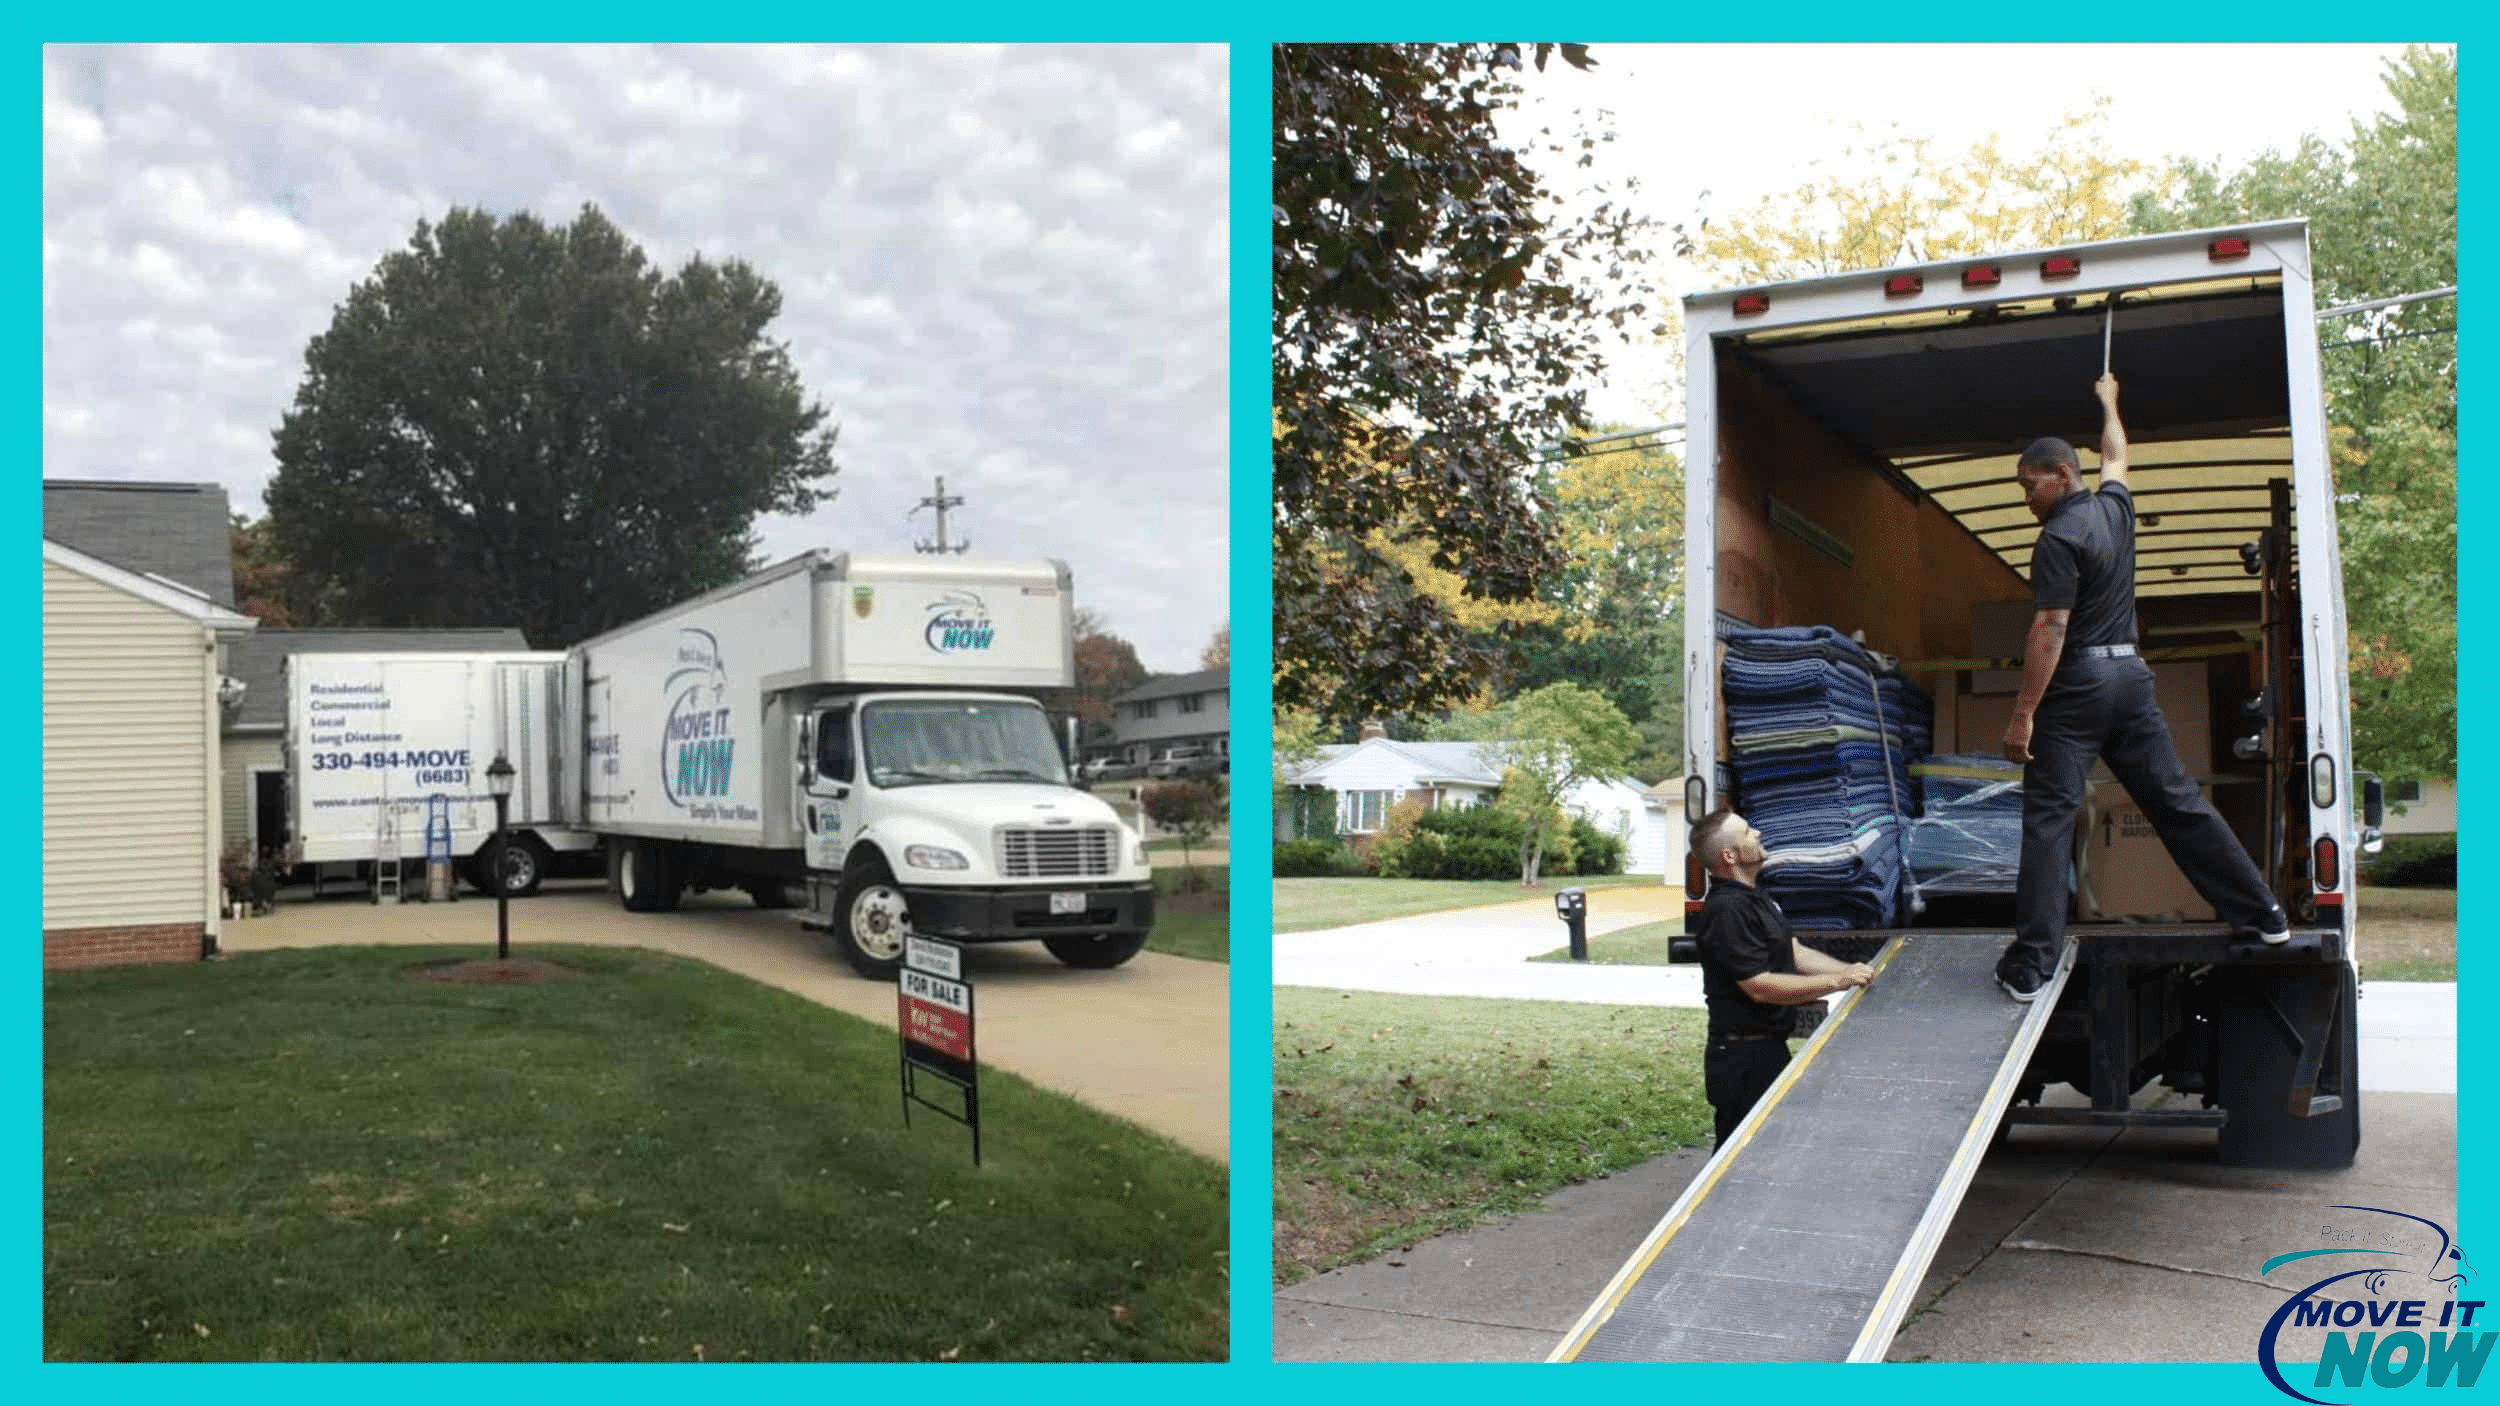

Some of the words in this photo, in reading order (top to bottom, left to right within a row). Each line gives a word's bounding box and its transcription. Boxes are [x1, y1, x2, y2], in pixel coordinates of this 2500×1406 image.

[935, 619, 975, 629] MOVE
[976, 619, 993, 629] IT
[941, 629, 995, 649] NOW
[310, 682, 384, 694] Residential
[310, 699, 391, 711] Commercial
[311, 716, 346, 727] Local
[669, 711, 712, 740] MOVE
[714, 708, 731, 736] IT
[311, 733, 343, 747] Long
[345, 732, 402, 743] Distance
[312, 750, 470, 770] 330-494-MOVE
[676, 737, 736, 797] NOW
[416, 769, 470, 787] (6683)
[907, 973, 928, 994] FOR
[931, 981, 961, 1006] SALE
